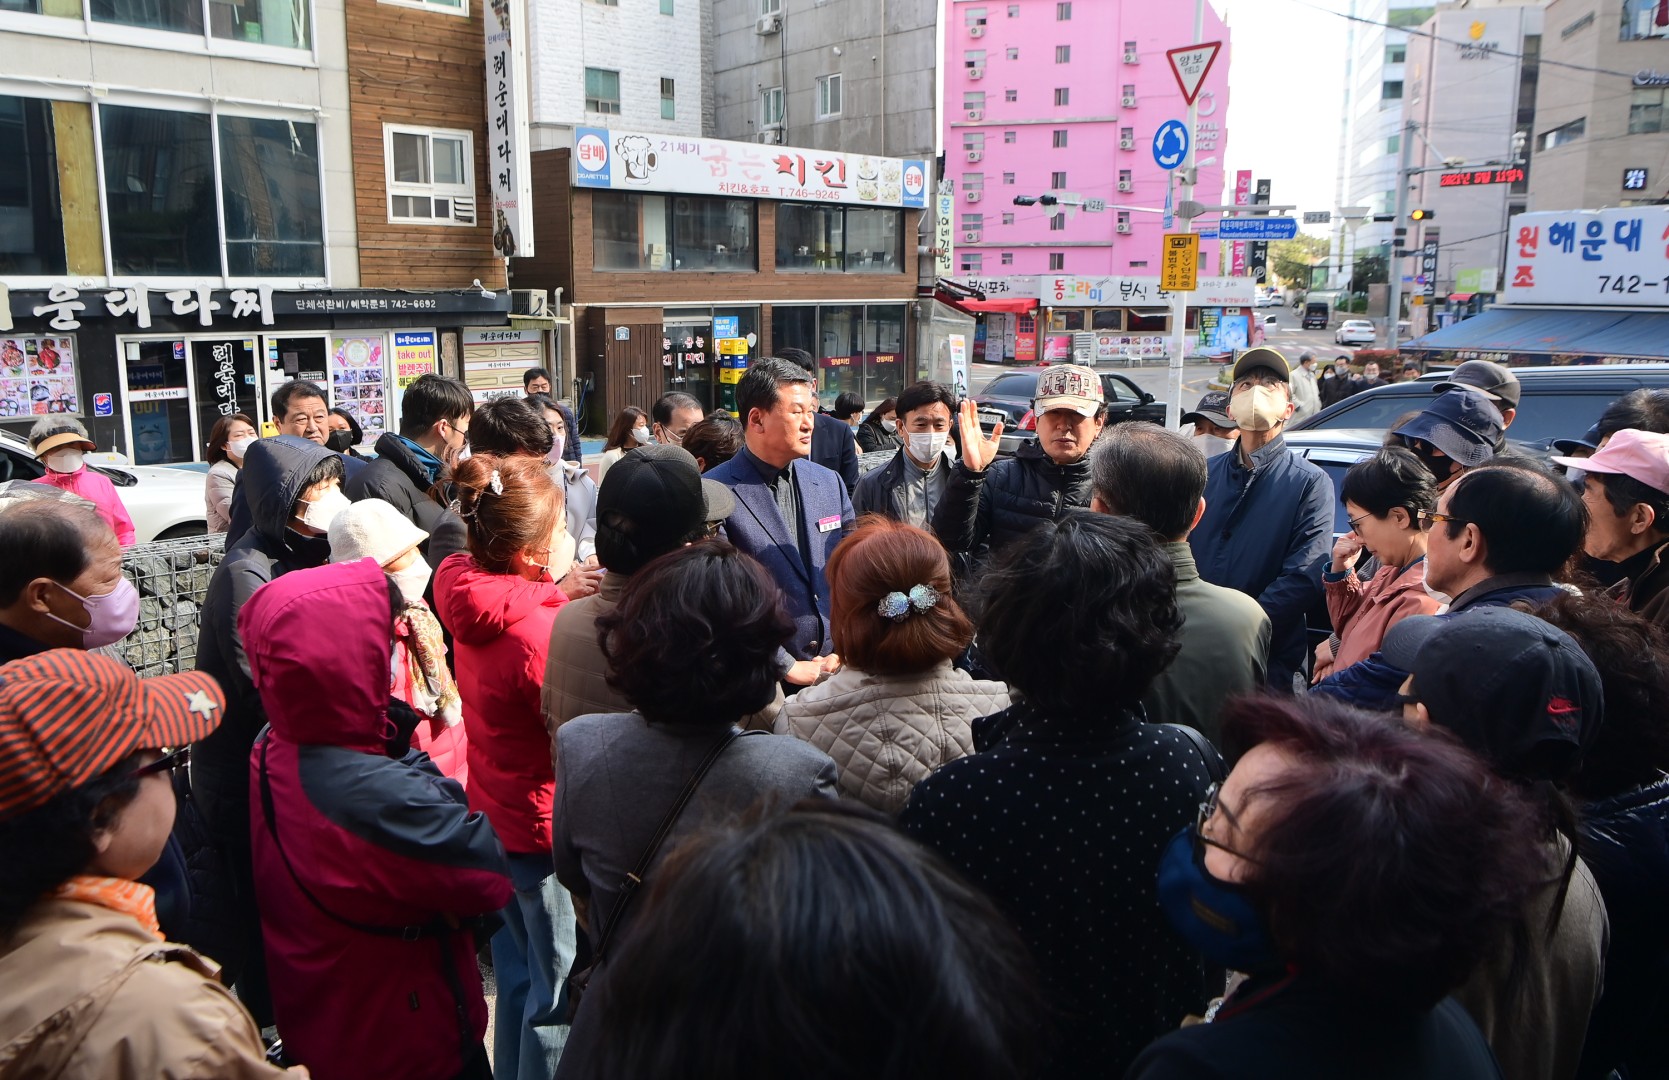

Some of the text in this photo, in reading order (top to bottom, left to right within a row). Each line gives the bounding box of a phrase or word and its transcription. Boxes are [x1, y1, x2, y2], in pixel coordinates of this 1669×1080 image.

[1179, 53, 1203, 66] 양보
[1184, 65, 1200, 75] YIELD
[493, 51, 512, 192] 해운대다찌
[579, 144, 605, 162] 담배
[660, 141, 848, 189] 21세기 굽는 치킨
[577, 172, 609, 181] CIGARETTES
[905, 174, 922, 186] 담배
[718, 182, 840, 200] 치킨&호프 T.746-9245
[1548, 218, 1643, 261] 해운대
[1511, 226, 1540, 288] 원조
[1053, 279, 1102, 302] 동그라미
[1120, 281, 1175, 301] 분식 포
[0, 283, 275, 331] 운대다찌
[295, 299, 436, 311] 단체석완비/예약문의 742-6692
[480, 331, 521, 341] 해운대다찌
[397, 350, 431, 360] take out
[398, 362, 432, 376] 발렛주차
[984, 415, 998, 423] 5021
